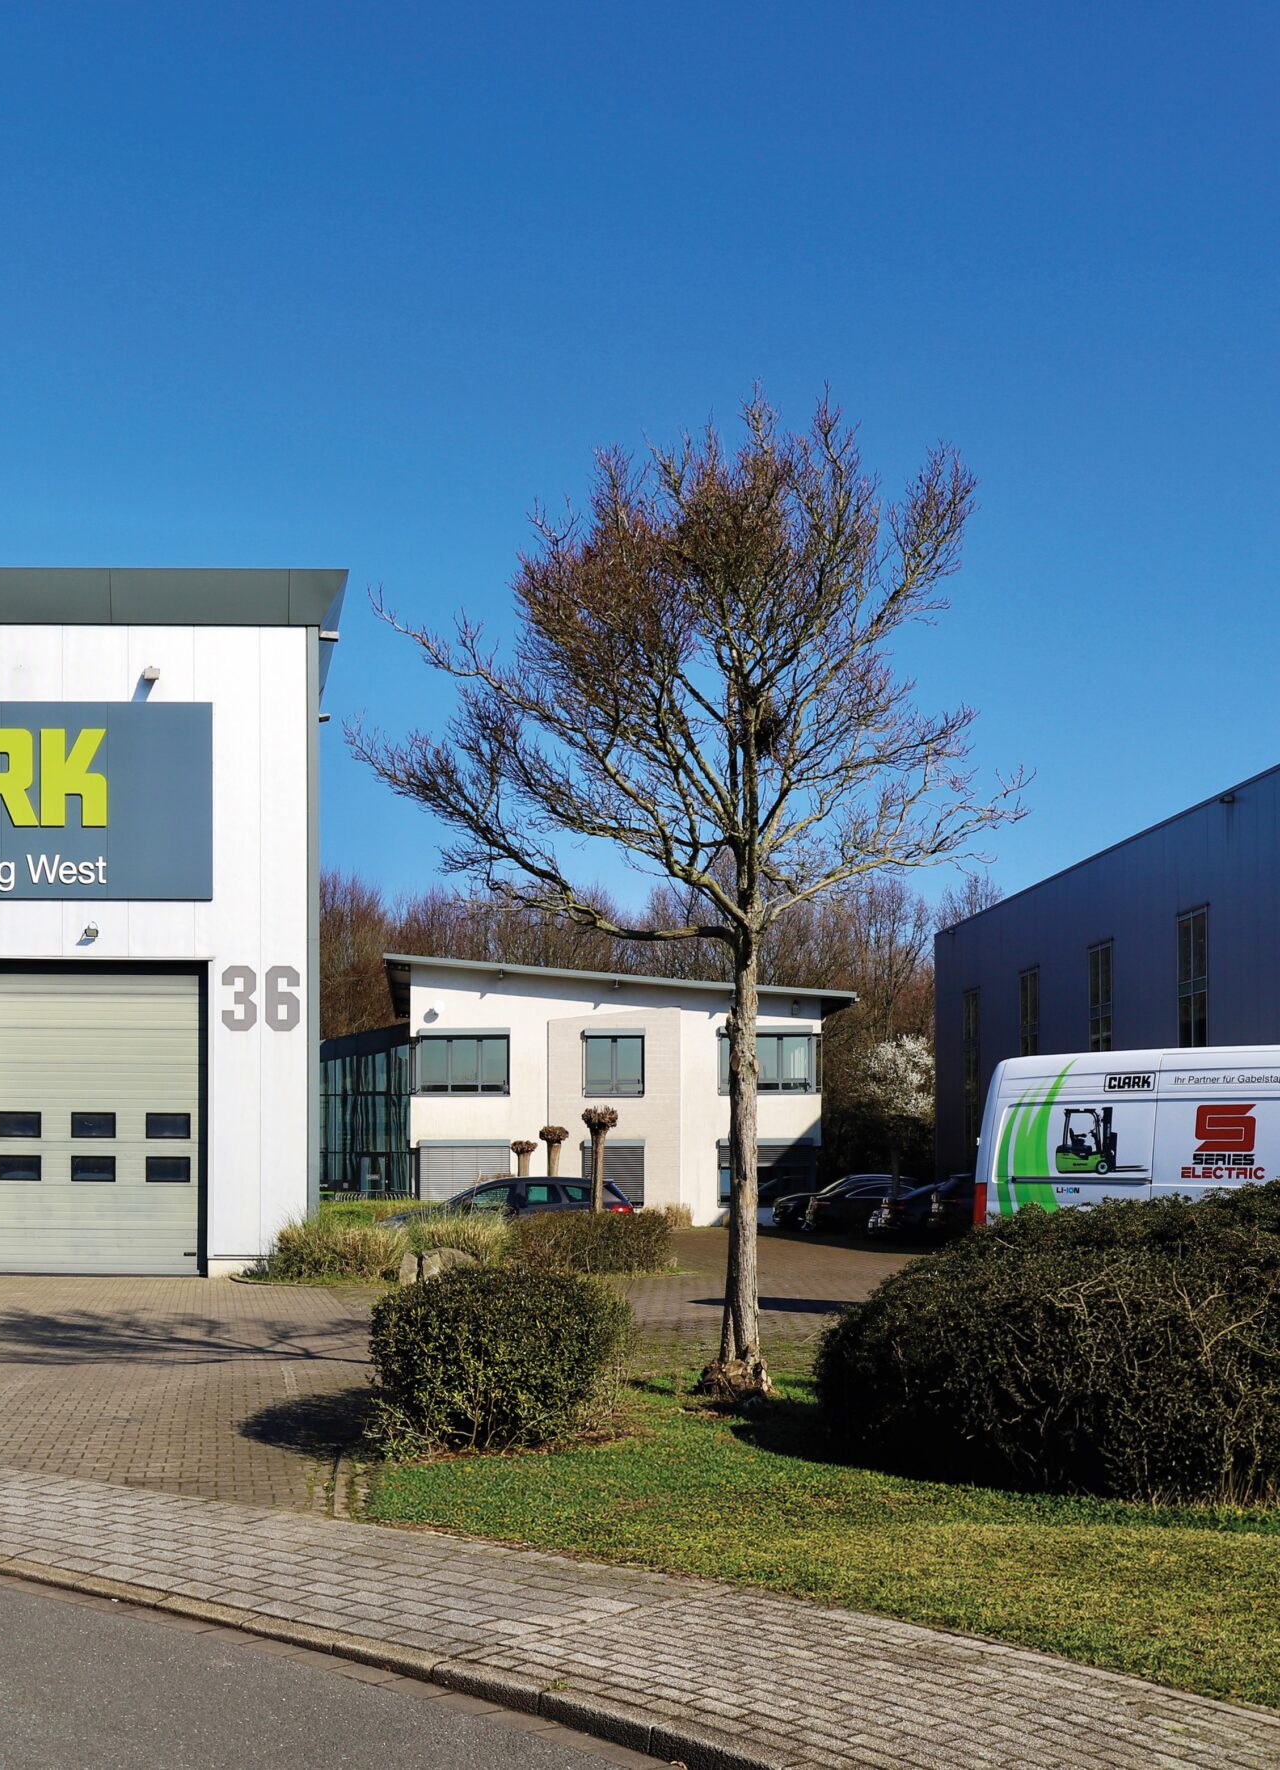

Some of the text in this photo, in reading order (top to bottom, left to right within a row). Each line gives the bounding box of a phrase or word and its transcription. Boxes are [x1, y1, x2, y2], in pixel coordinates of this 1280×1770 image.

[26, 854, 107, 884] West
[221, 965, 301, 1032] 36
[1108, 1075, 1151, 1089] CLARK
[1174, 1074, 1280, 1084] Ihr Partner für Gabelsta
[1192, 1153, 1255, 1166] SERIES
[1181, 1166, 1265, 1180] ELECTRIC
